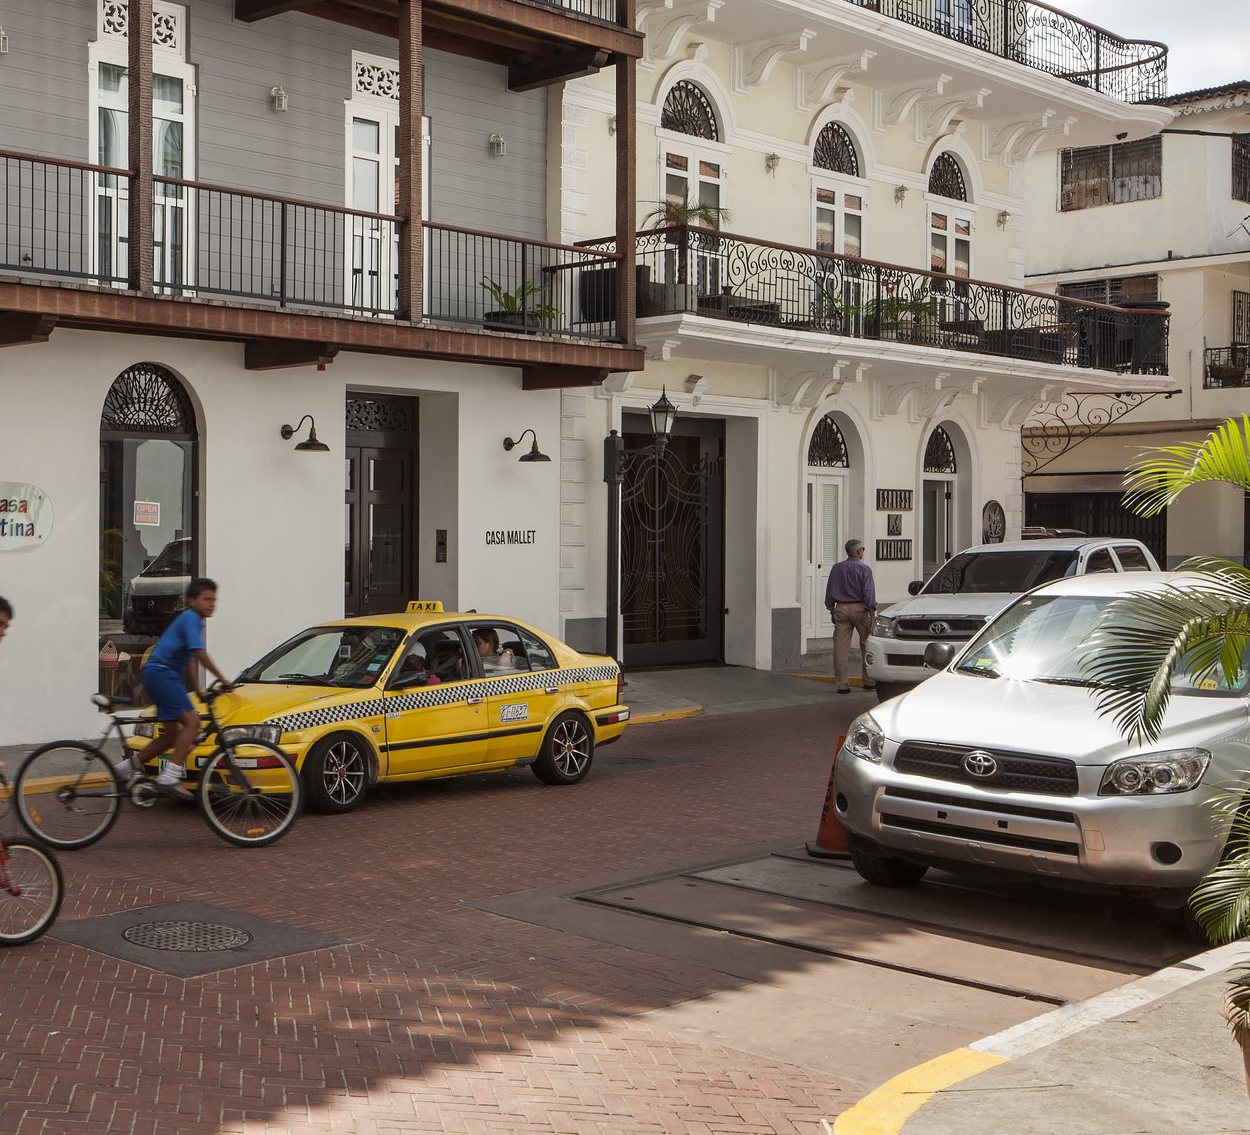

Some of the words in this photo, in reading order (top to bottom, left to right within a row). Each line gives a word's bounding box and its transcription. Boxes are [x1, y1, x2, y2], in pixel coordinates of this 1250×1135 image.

[136, 504, 158, 513] OPEN
[485, 530, 506, 545] CASA
[507, 530, 536, 544] MALLET
[411, 602, 436, 611] TAXI
